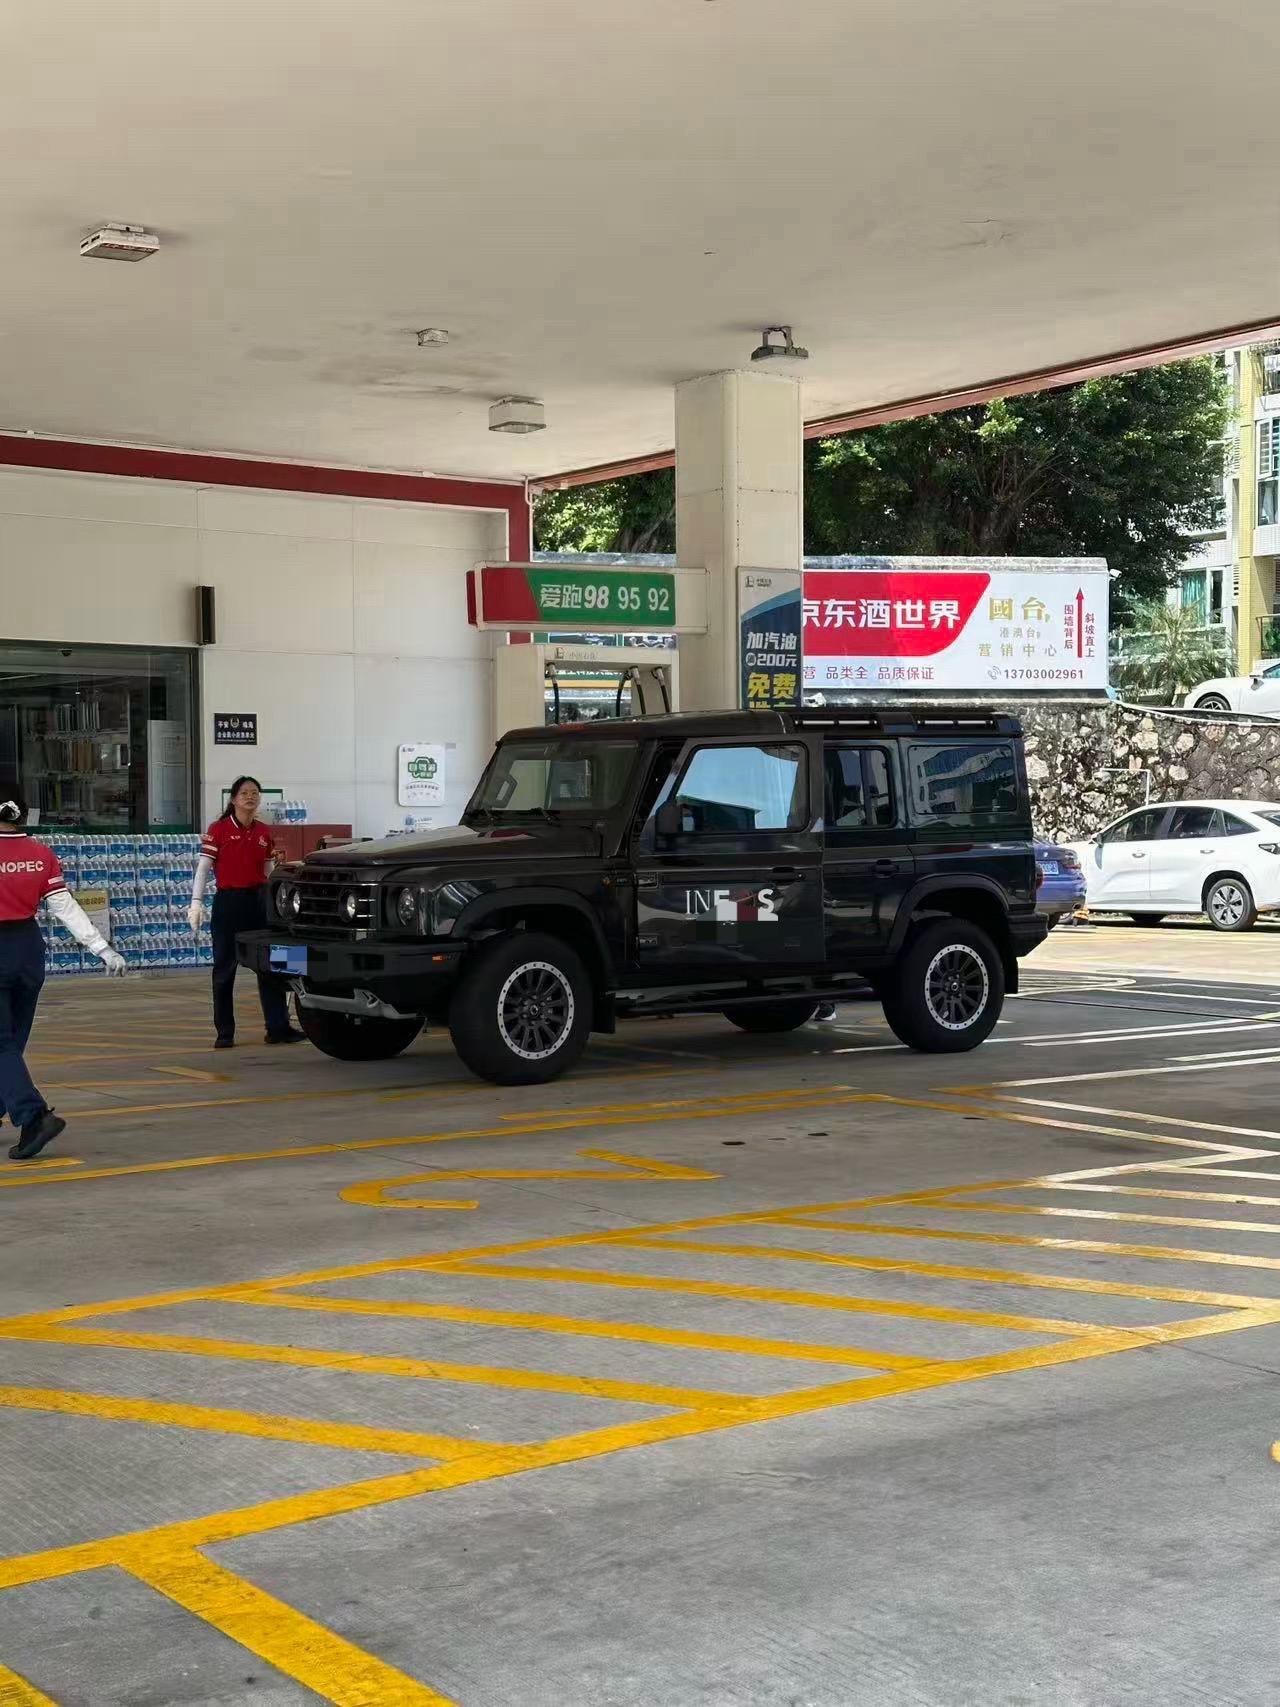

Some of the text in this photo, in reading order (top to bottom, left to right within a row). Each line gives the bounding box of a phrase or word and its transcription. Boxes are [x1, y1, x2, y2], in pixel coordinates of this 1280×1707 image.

[540, 584, 669, 611] 爱跑98 95 92
[1064, 604, 1074, 650] 围墙背后
[1085, 612, 1095, 658] 斜坡直上
[746, 631, 797, 650] 加汽油
[979, 643, 1057, 657] 营销中心
[826, 666, 868, 680] 品类全
[878, 666, 934, 680] 品质保证
[1004, 669, 1083, 679] 13703002961
[747, 672, 796, 699] 免费
